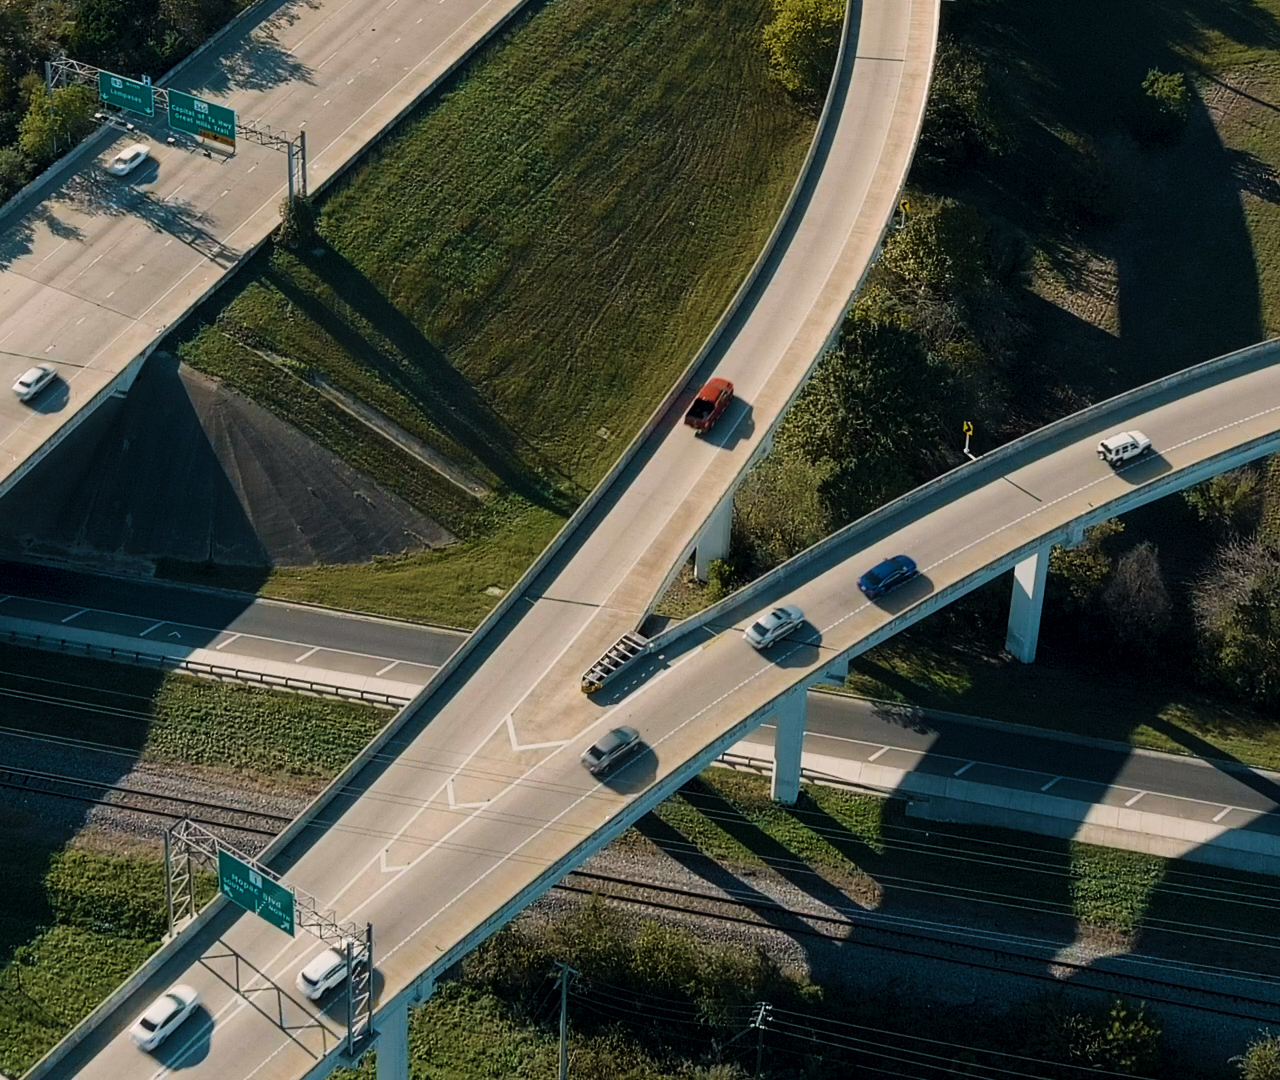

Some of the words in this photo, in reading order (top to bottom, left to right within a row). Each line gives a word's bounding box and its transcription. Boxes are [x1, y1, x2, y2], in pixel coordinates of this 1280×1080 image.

[171, 104, 195, 117] Capital
[218, 119, 232, 130] Hwy
[174, 112, 193, 123] Great
[195, 119, 211, 129] Hills
[213, 125, 229, 135] Trail
[223, 876, 244, 894] SOUTH
[262, 892, 282, 908] Blvd
[268, 905, 291, 922] NORTH
